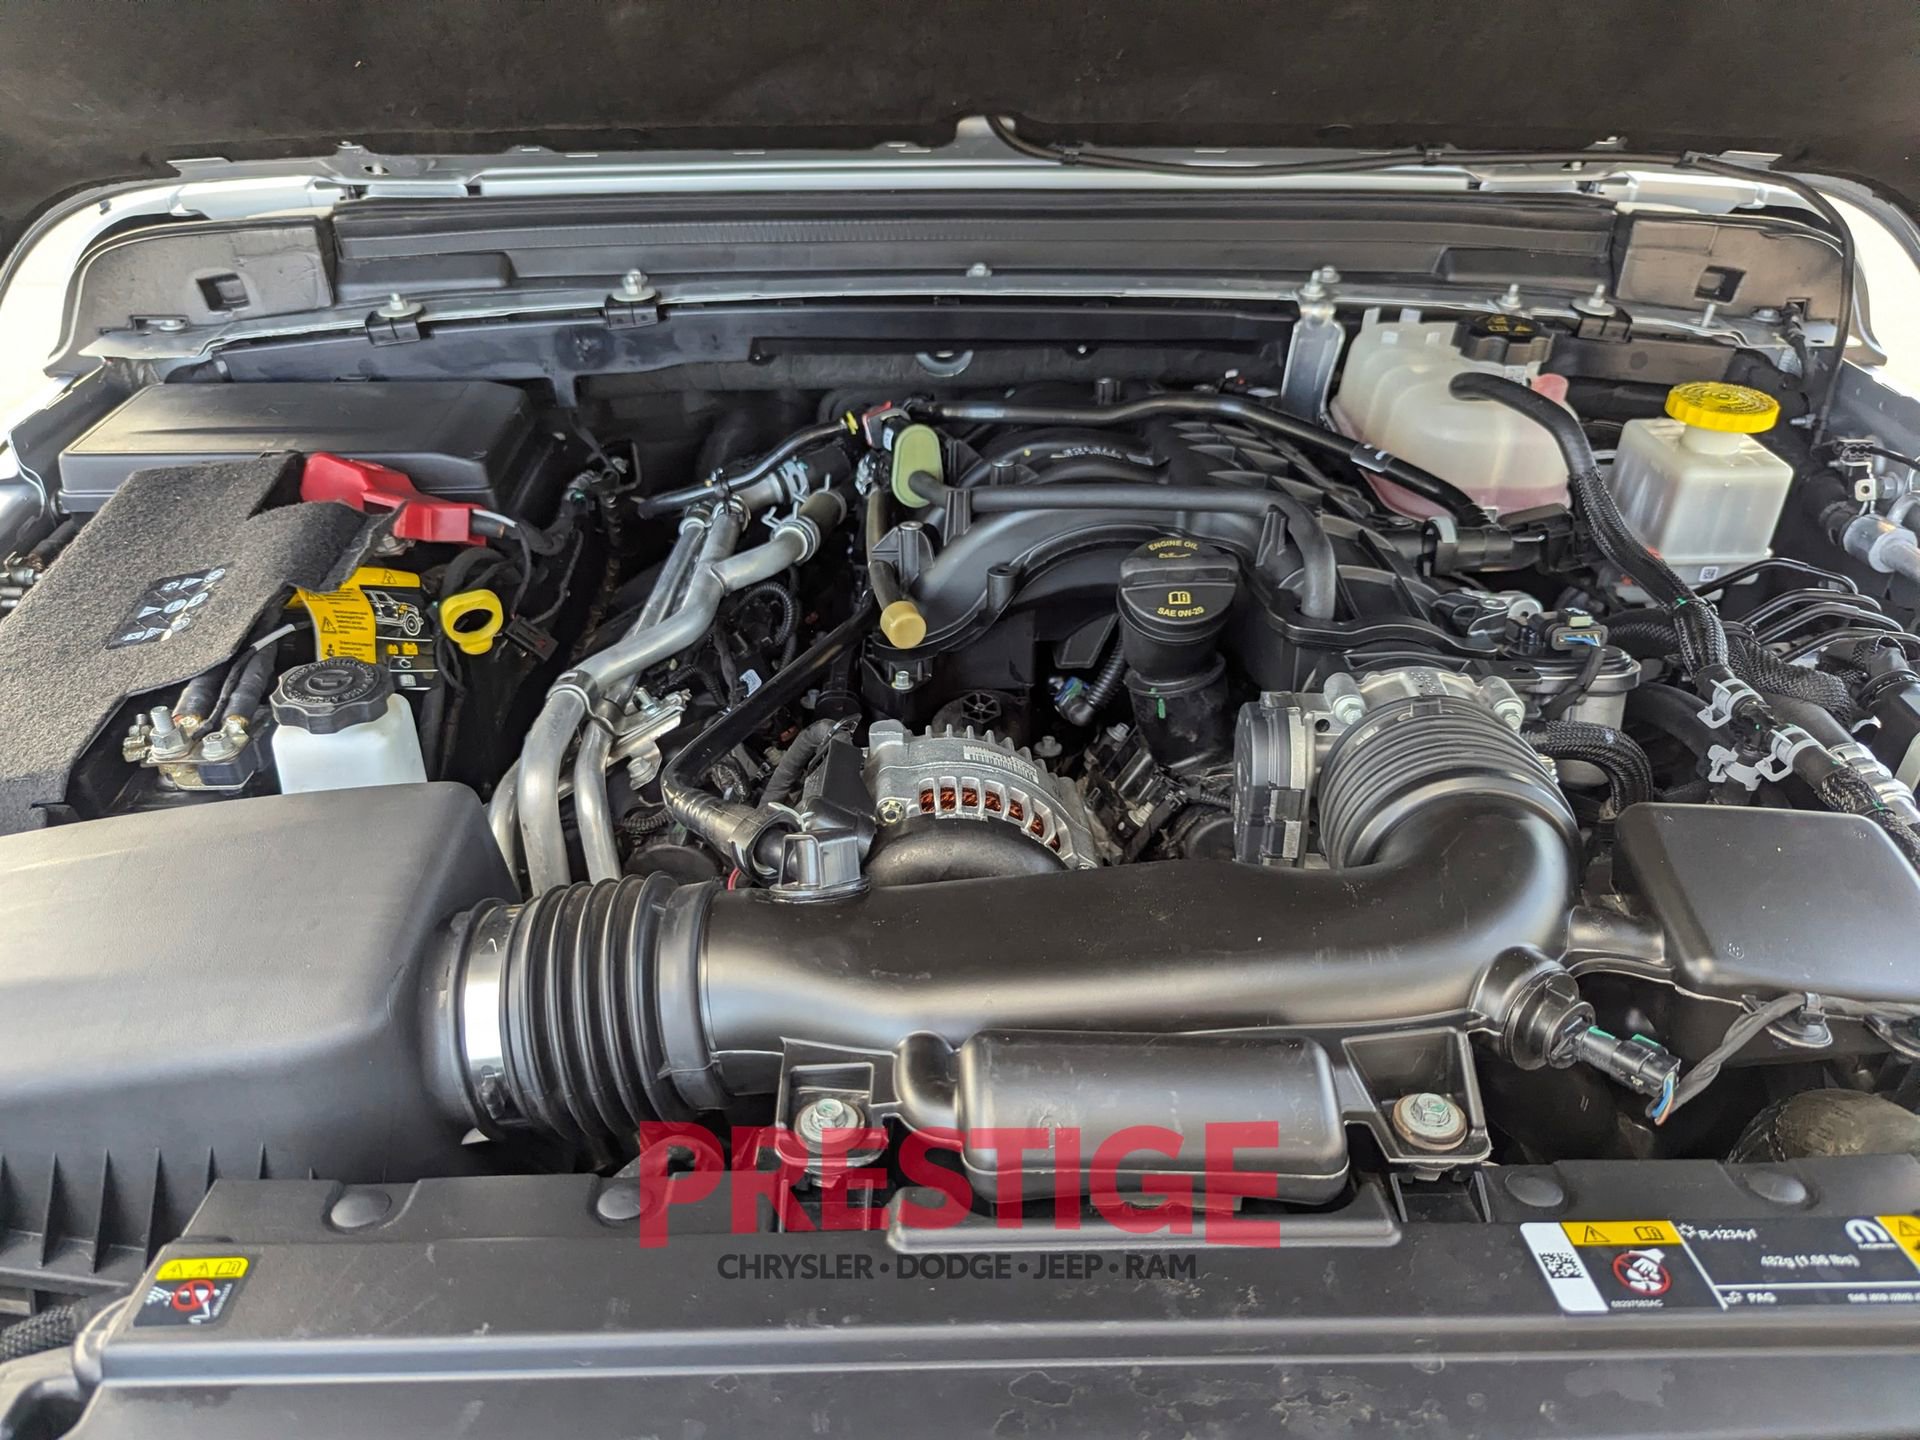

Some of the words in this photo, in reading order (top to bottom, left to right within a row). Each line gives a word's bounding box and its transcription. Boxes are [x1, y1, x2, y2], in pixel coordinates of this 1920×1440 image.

[1148, 540, 1181, 550] ENGINE
[1184, 541, 1198, 550] OIL
[1157, 607, 1176, 617] SAE
[1178, 606, 1204, 617] 0W-20
